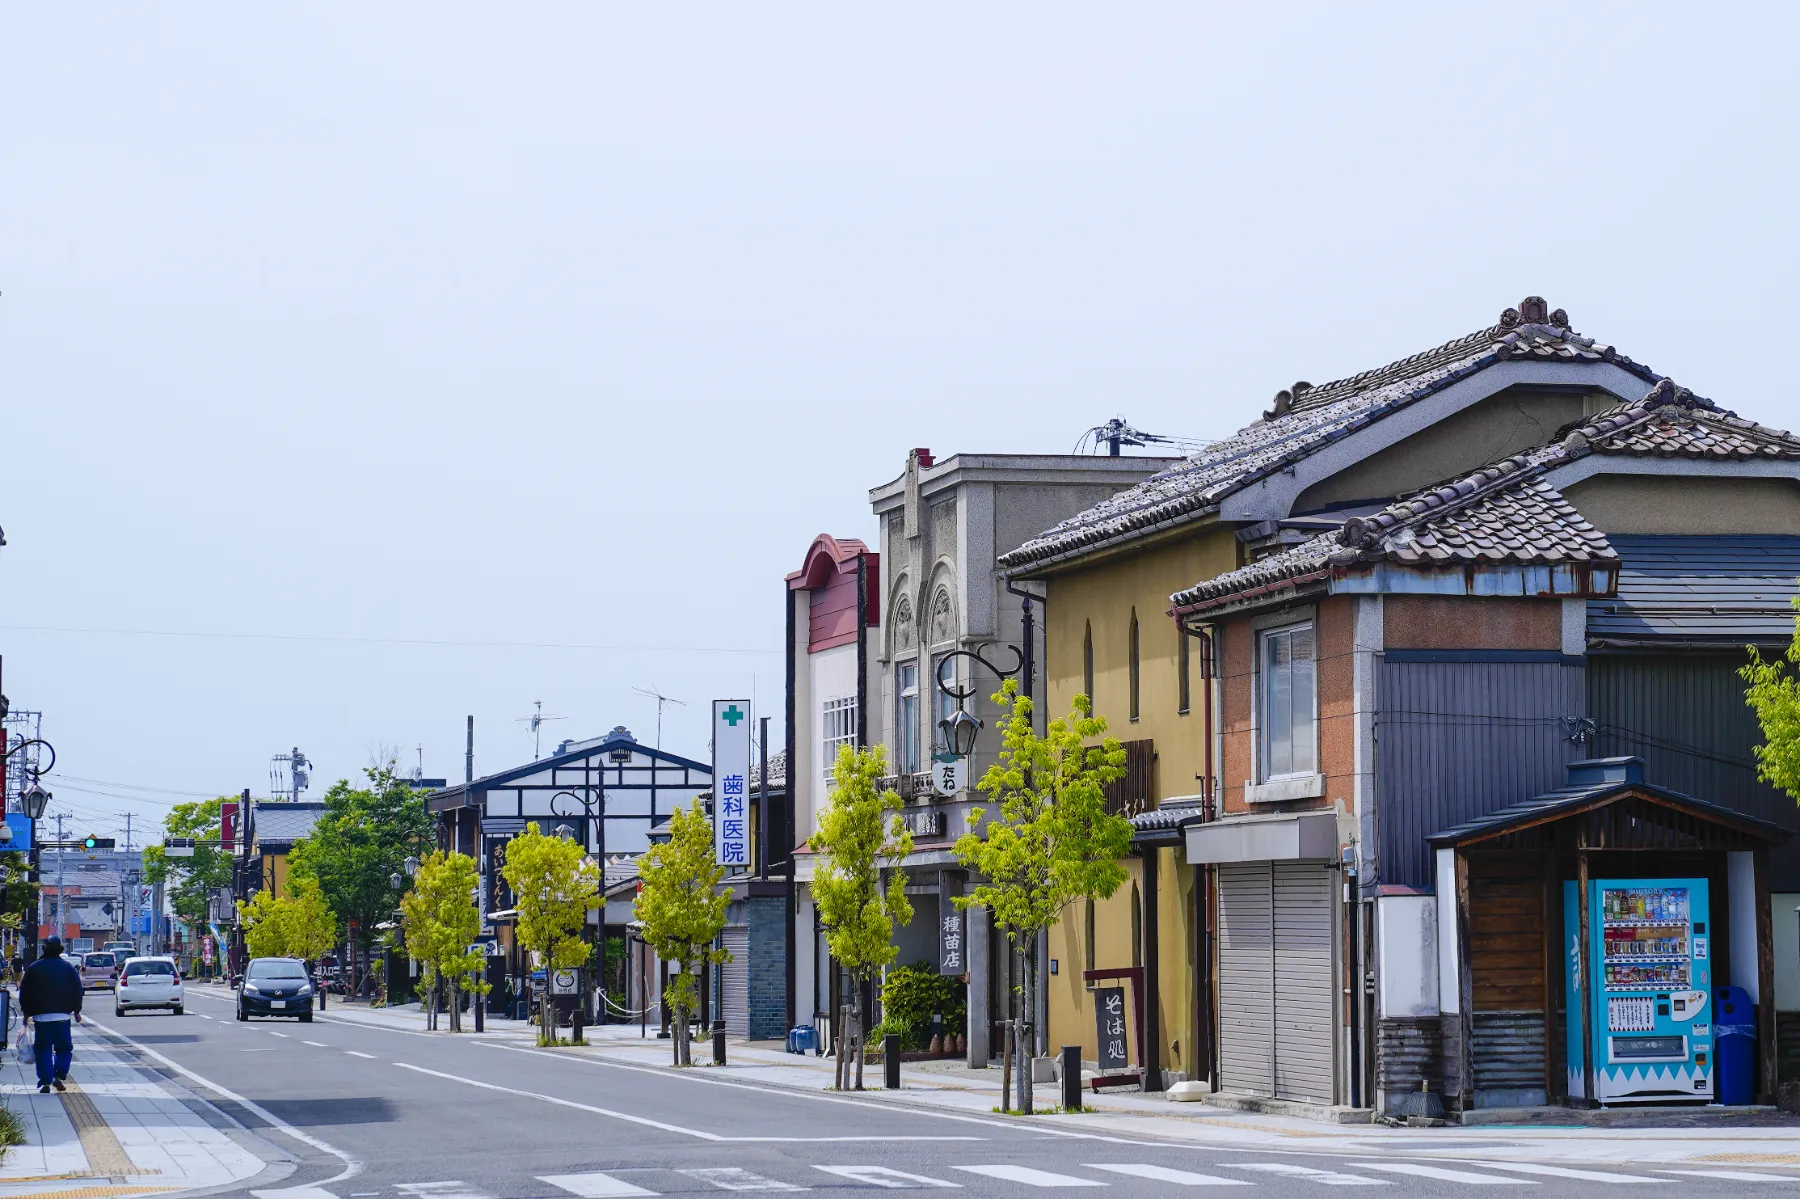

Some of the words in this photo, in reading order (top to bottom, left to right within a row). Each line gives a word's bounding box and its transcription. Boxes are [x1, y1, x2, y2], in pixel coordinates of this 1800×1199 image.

[942, 765, 956, 791] たね
[722, 773, 744, 863] 歯科医院
[942, 915, 961, 968] 種苗店
[1105, 994, 1126, 1060] そば処
